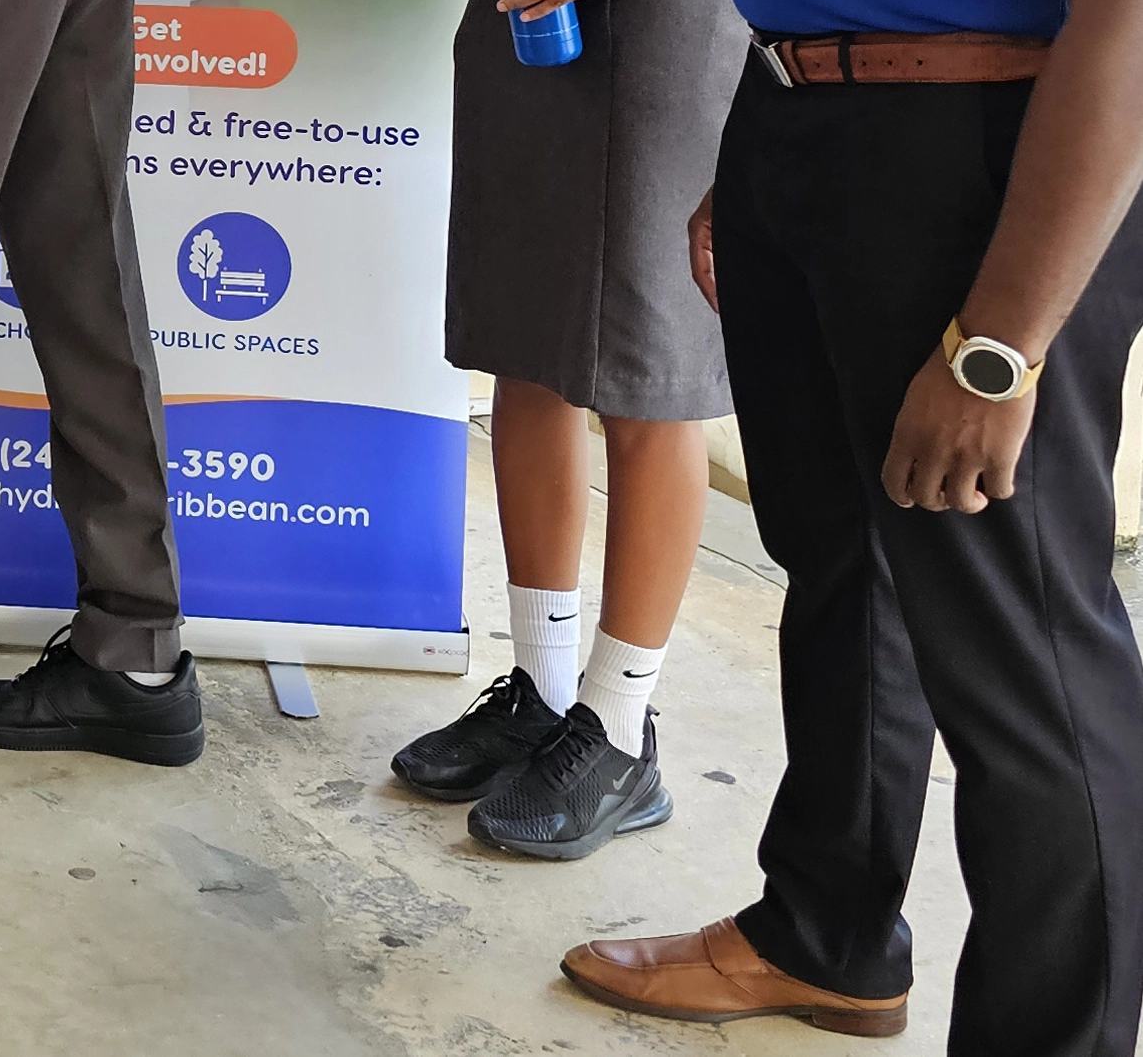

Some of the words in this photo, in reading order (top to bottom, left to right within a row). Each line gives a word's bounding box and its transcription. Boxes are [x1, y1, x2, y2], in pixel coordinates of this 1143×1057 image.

[134, 49, 267, 76] nvolved!
[188, 111, 212, 137] &
[225, 112, 420, 146] free-to-use
[170, 156, 383, 186] everywhere:
[149, 329, 226, 350] PUBLIC
[234, 334, 320, 355] SPACES
